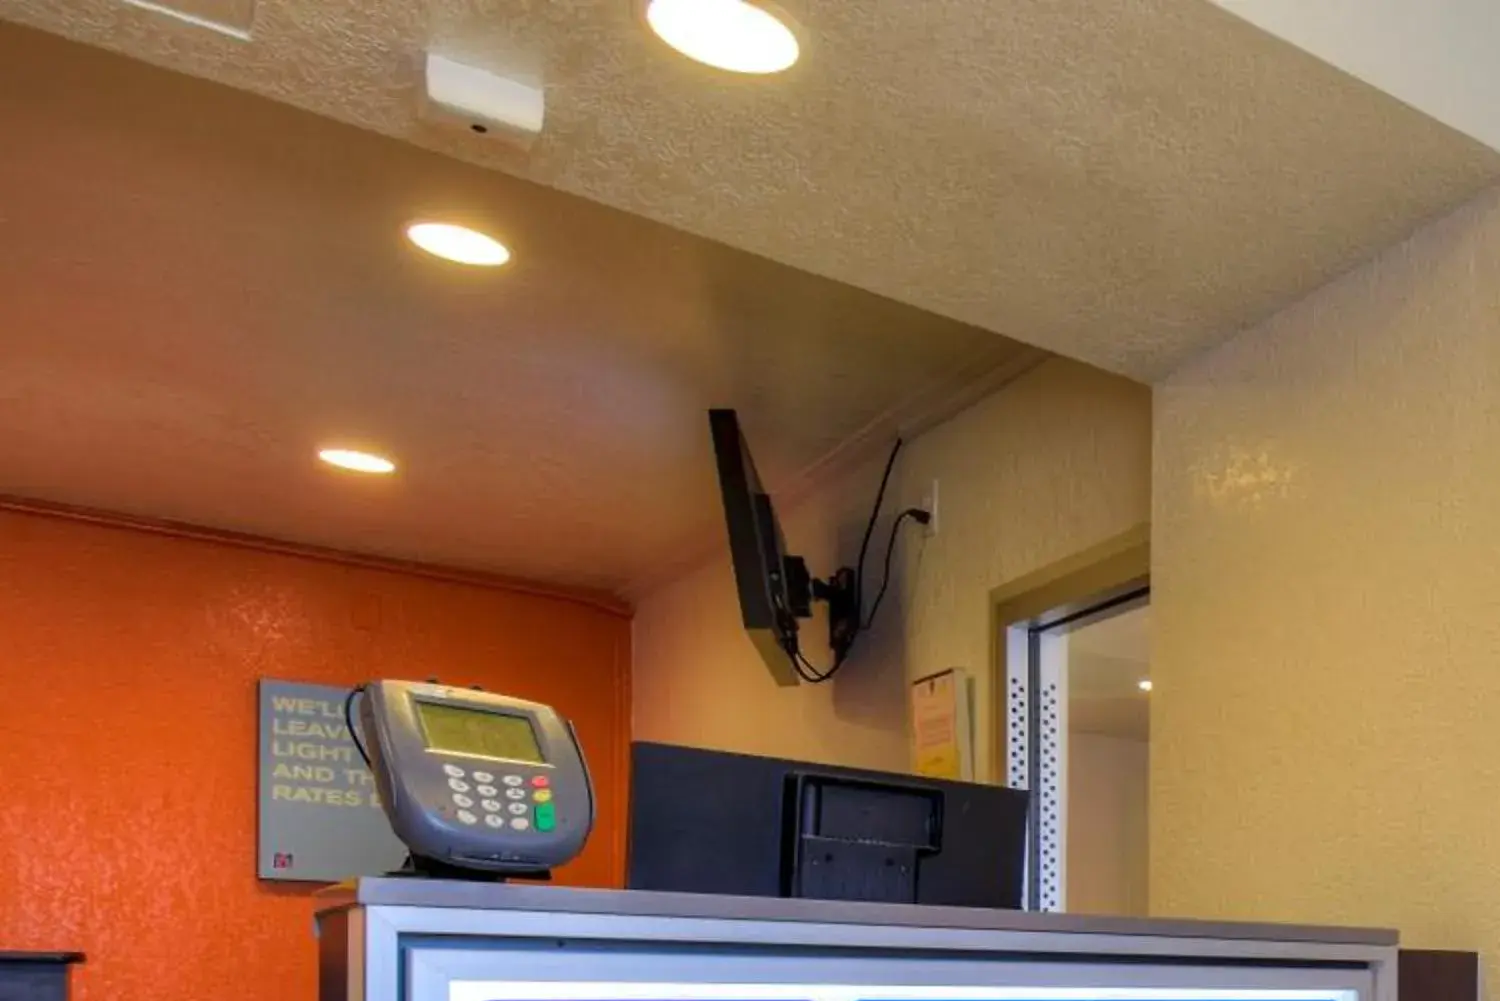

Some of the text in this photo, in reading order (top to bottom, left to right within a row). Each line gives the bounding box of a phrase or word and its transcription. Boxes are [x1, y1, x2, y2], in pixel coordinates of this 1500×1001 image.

[272, 718, 352, 739] LEAV
[272, 741, 352, 763] LIGHT
[272, 763, 375, 786] AND TH
[272, 784, 362, 807] RATES
